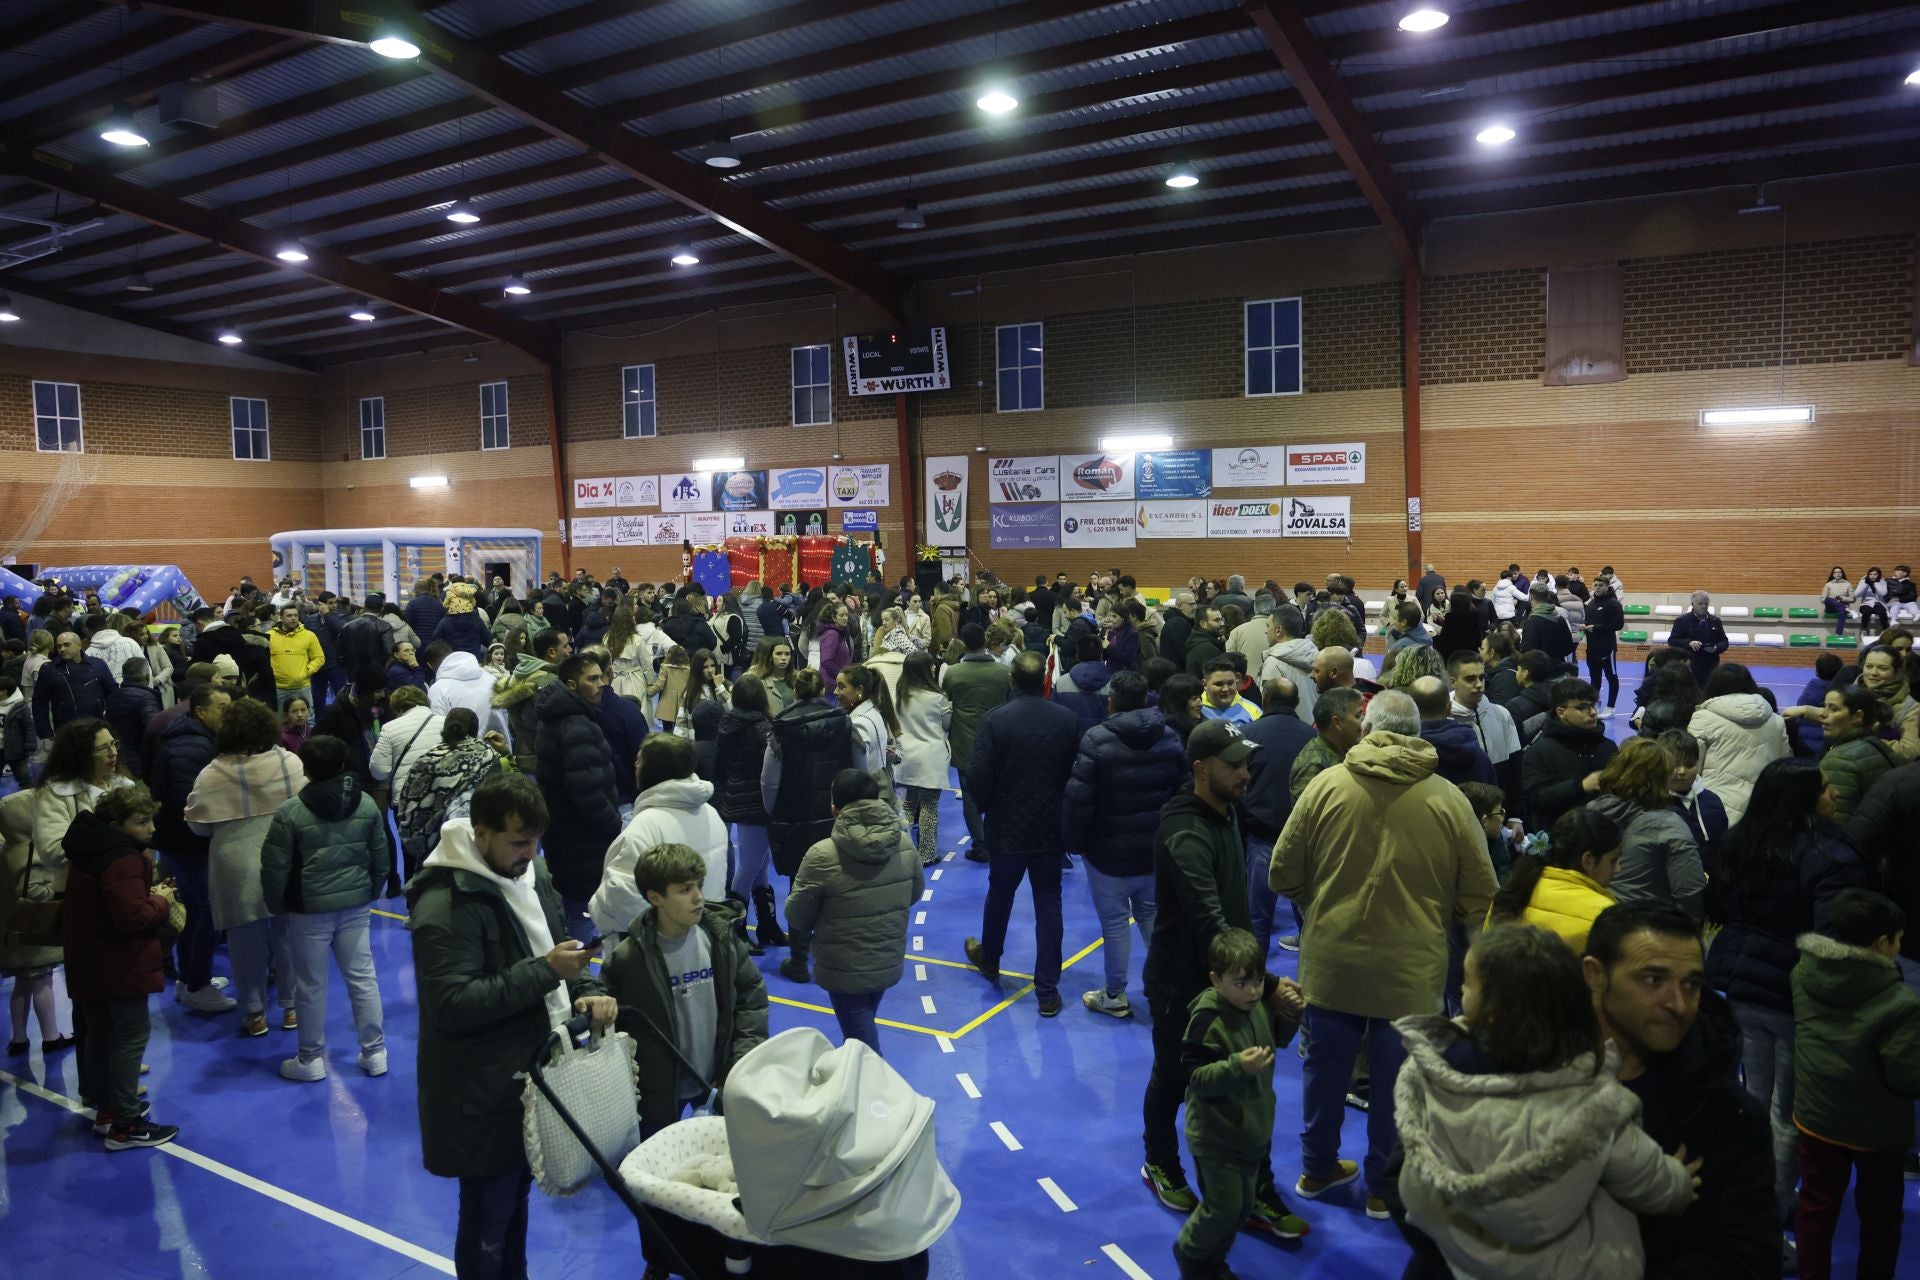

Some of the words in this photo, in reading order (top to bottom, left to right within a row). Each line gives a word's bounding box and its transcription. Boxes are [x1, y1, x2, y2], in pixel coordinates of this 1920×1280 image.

[848, 353, 859, 394] WÜRTH
[880, 376, 934, 391] WÜRTH
[1301, 454, 1347, 463] SPAR
[578, 483, 599, 498] Dia
[603, 482, 613, 496] %
[837, 488, 855, 496] TAXI
[1213, 504, 1239, 516] iber
[1287, 518, 1346, 528] JOVALSA
[1224, 721, 1243, 738] NY
